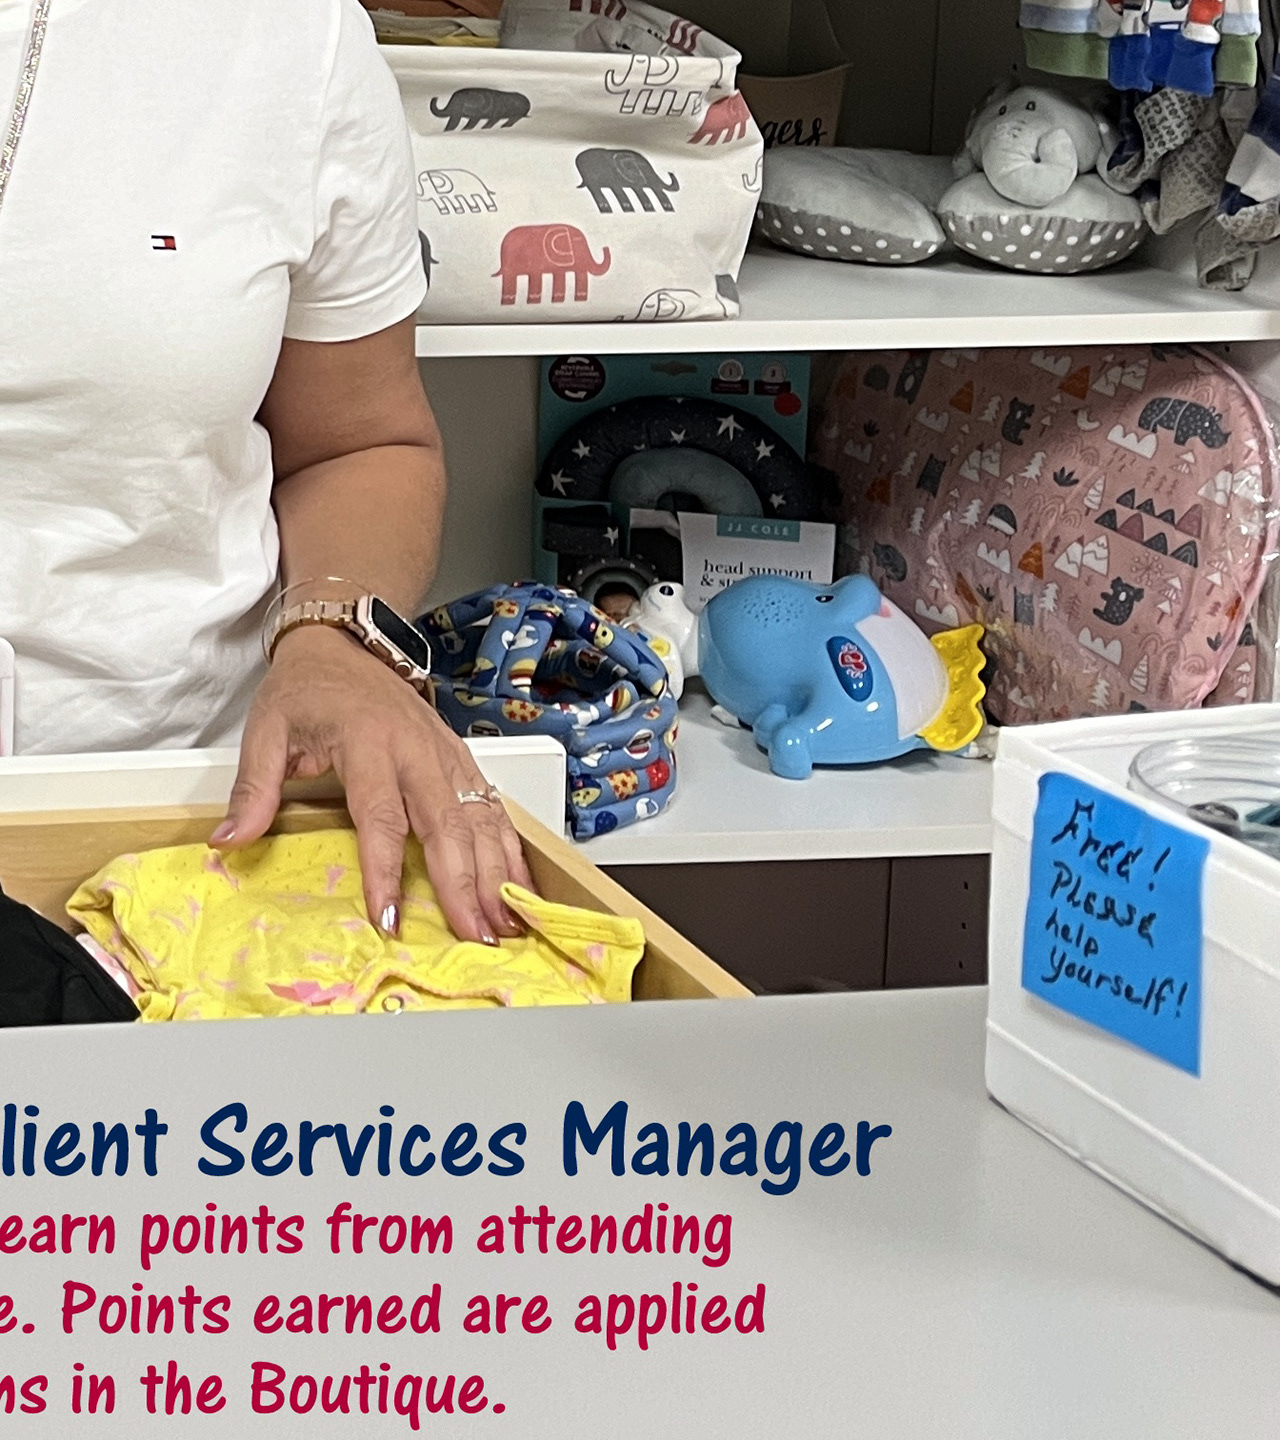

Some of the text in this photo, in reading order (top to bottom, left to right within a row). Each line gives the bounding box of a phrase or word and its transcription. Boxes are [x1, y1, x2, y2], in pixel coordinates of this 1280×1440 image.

[751, 522, 790, 537] COLE
[703, 558, 744, 575] head
[1051, 797, 1172, 892] Free!
[1045, 908, 1100, 957] help
